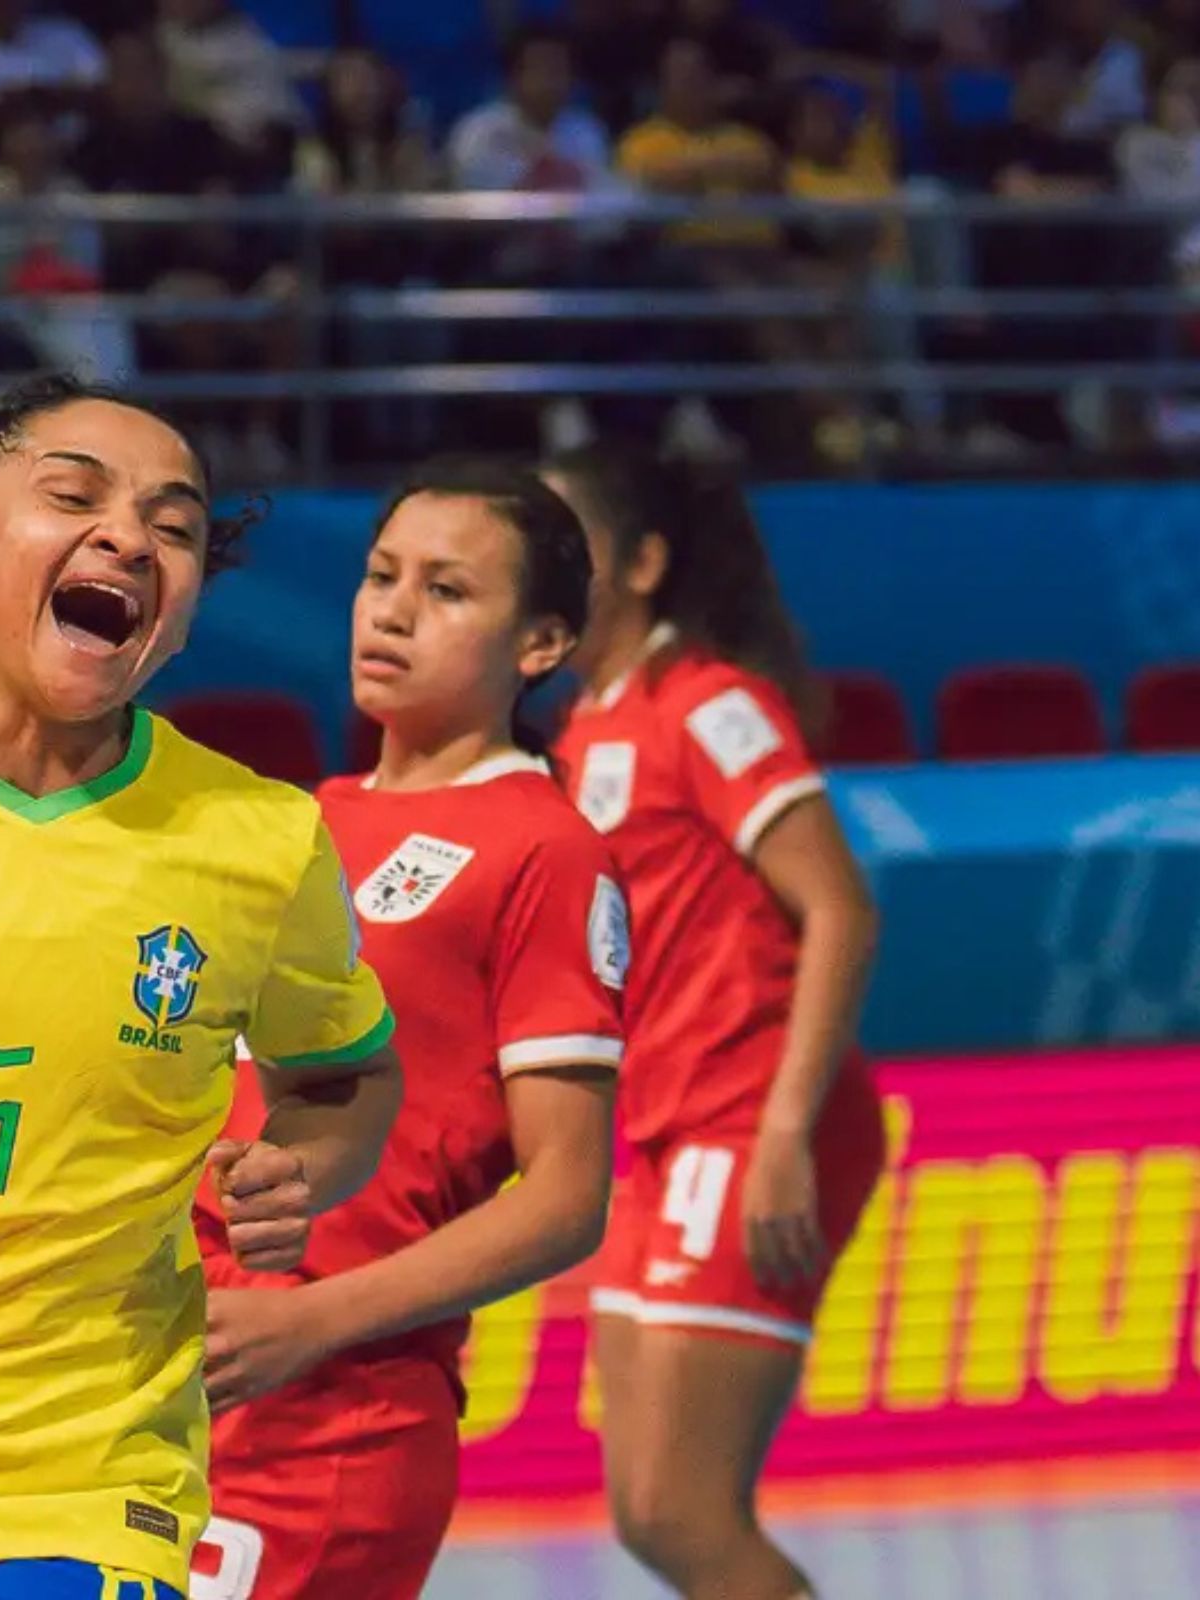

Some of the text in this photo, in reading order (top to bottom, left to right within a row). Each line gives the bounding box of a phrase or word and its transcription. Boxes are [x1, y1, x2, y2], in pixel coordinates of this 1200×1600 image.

[156, 965, 183, 981] CBF
[118, 1023, 184, 1055] BRASIL
[661, 1144, 736, 1260] 4
[578, 1093, 1200, 1432] inu
